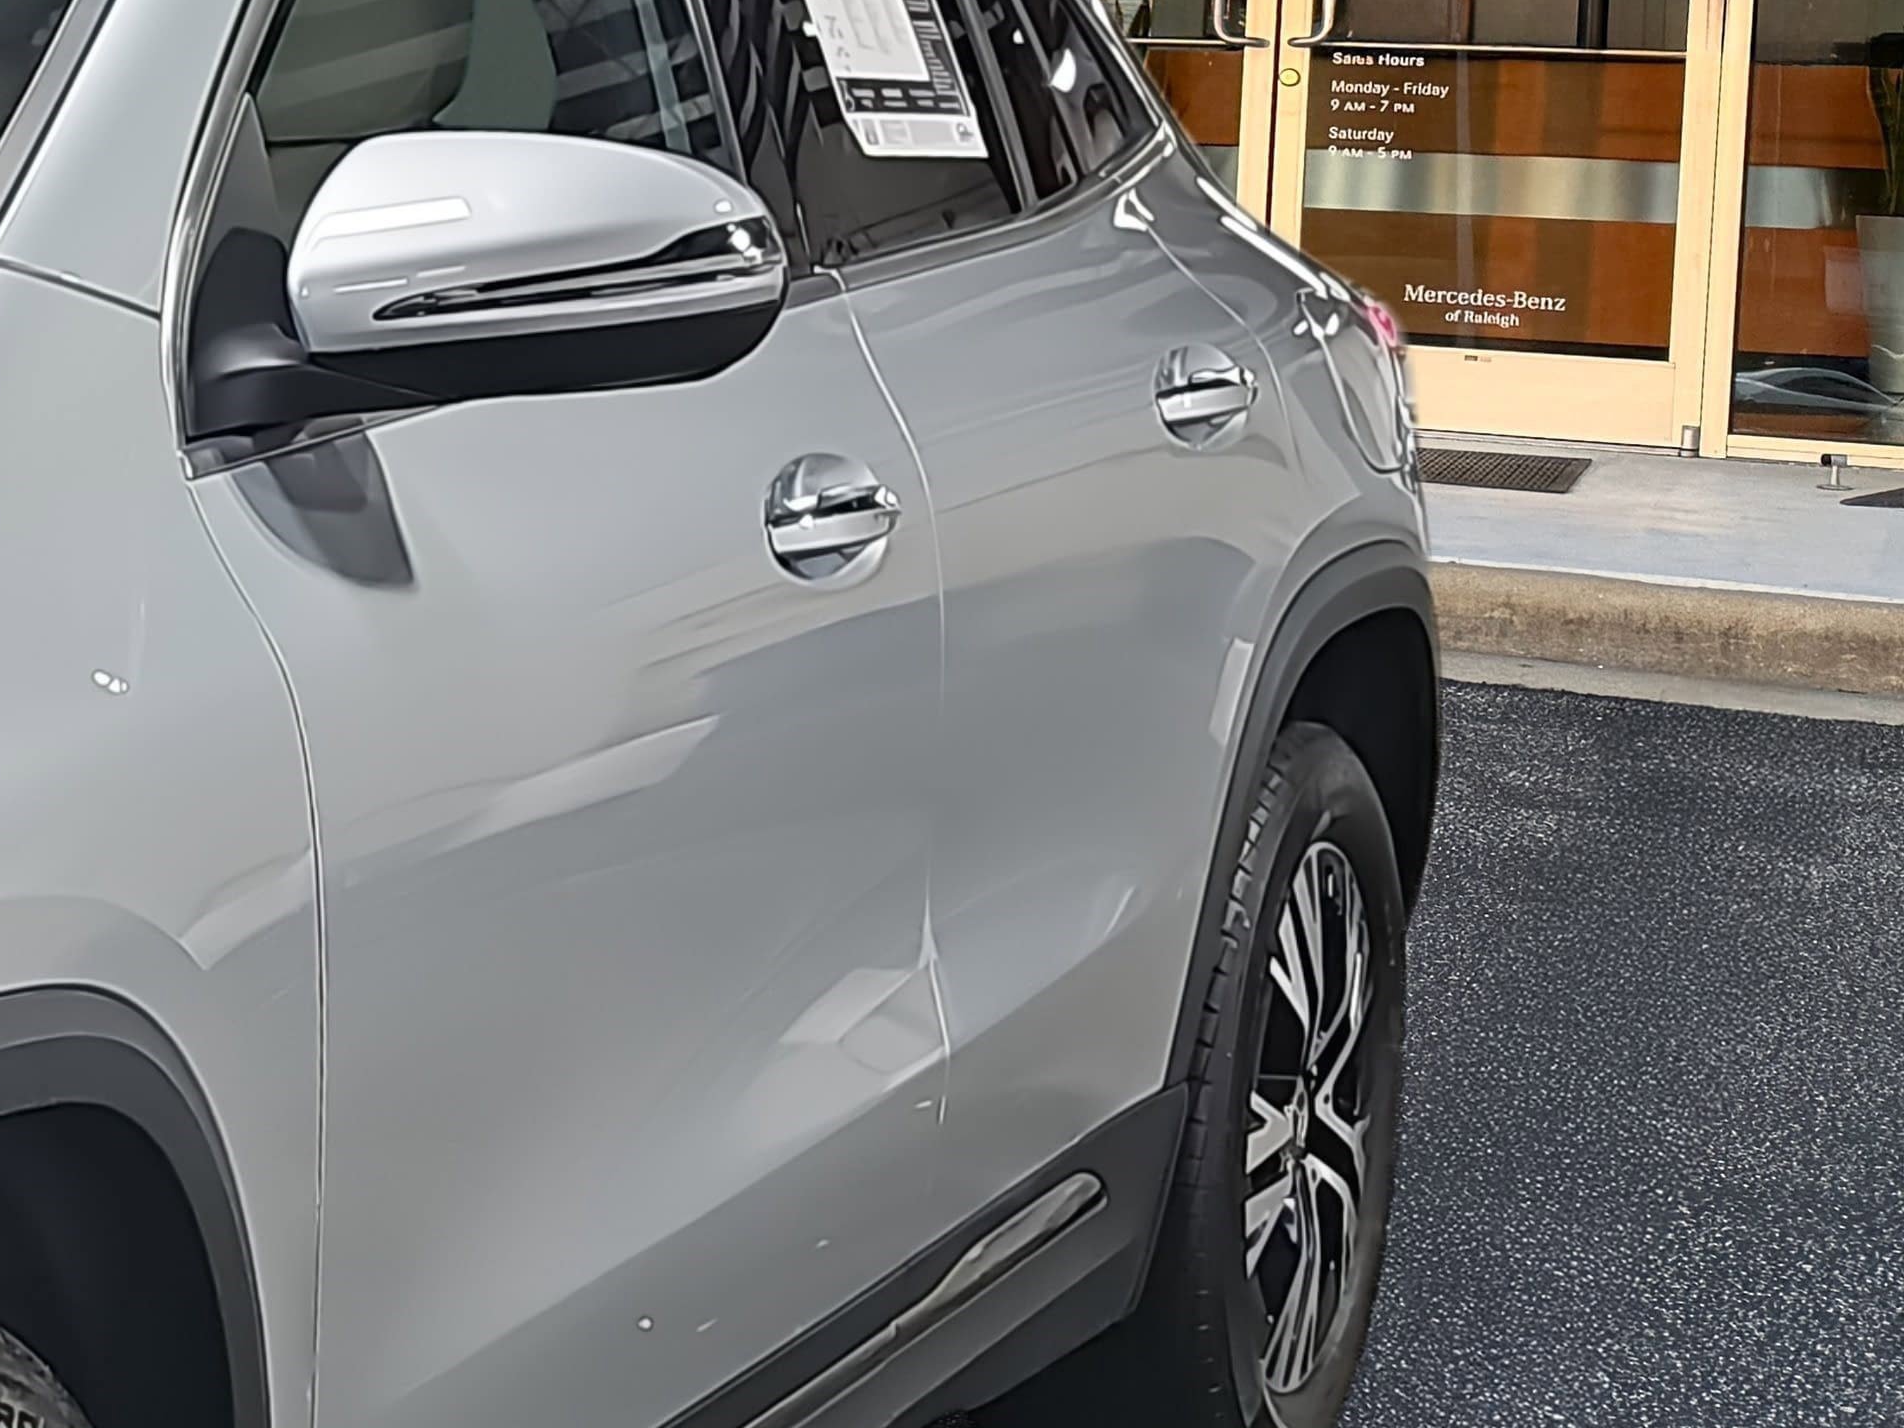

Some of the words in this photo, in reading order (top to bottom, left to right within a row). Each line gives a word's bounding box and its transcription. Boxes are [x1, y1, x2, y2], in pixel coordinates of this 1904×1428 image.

[1378, 53, 1425, 67] Hours
[1331, 80, 1390, 97] Monday
[1403, 82, 1449, 99] Friday
[1330, 98, 1340, 111] 9
[1343, 102, 1366, 112] AM
[1380, 99, 1389, 112] 7
[1393, 103, 1415, 113] PM
[1328, 126, 1394, 144] Saturday
[1328, 145, 1338, 157] 9
[1341, 148, 1364, 158] AM
[1377, 147, 1387, 159] 5
[1391, 150, 1412, 160] PM
[1403, 284, 1566, 312] Mercedes-Benz
[1445, 309, 1460, 323] of
[1463, 310, 1520, 328] Raleigh
